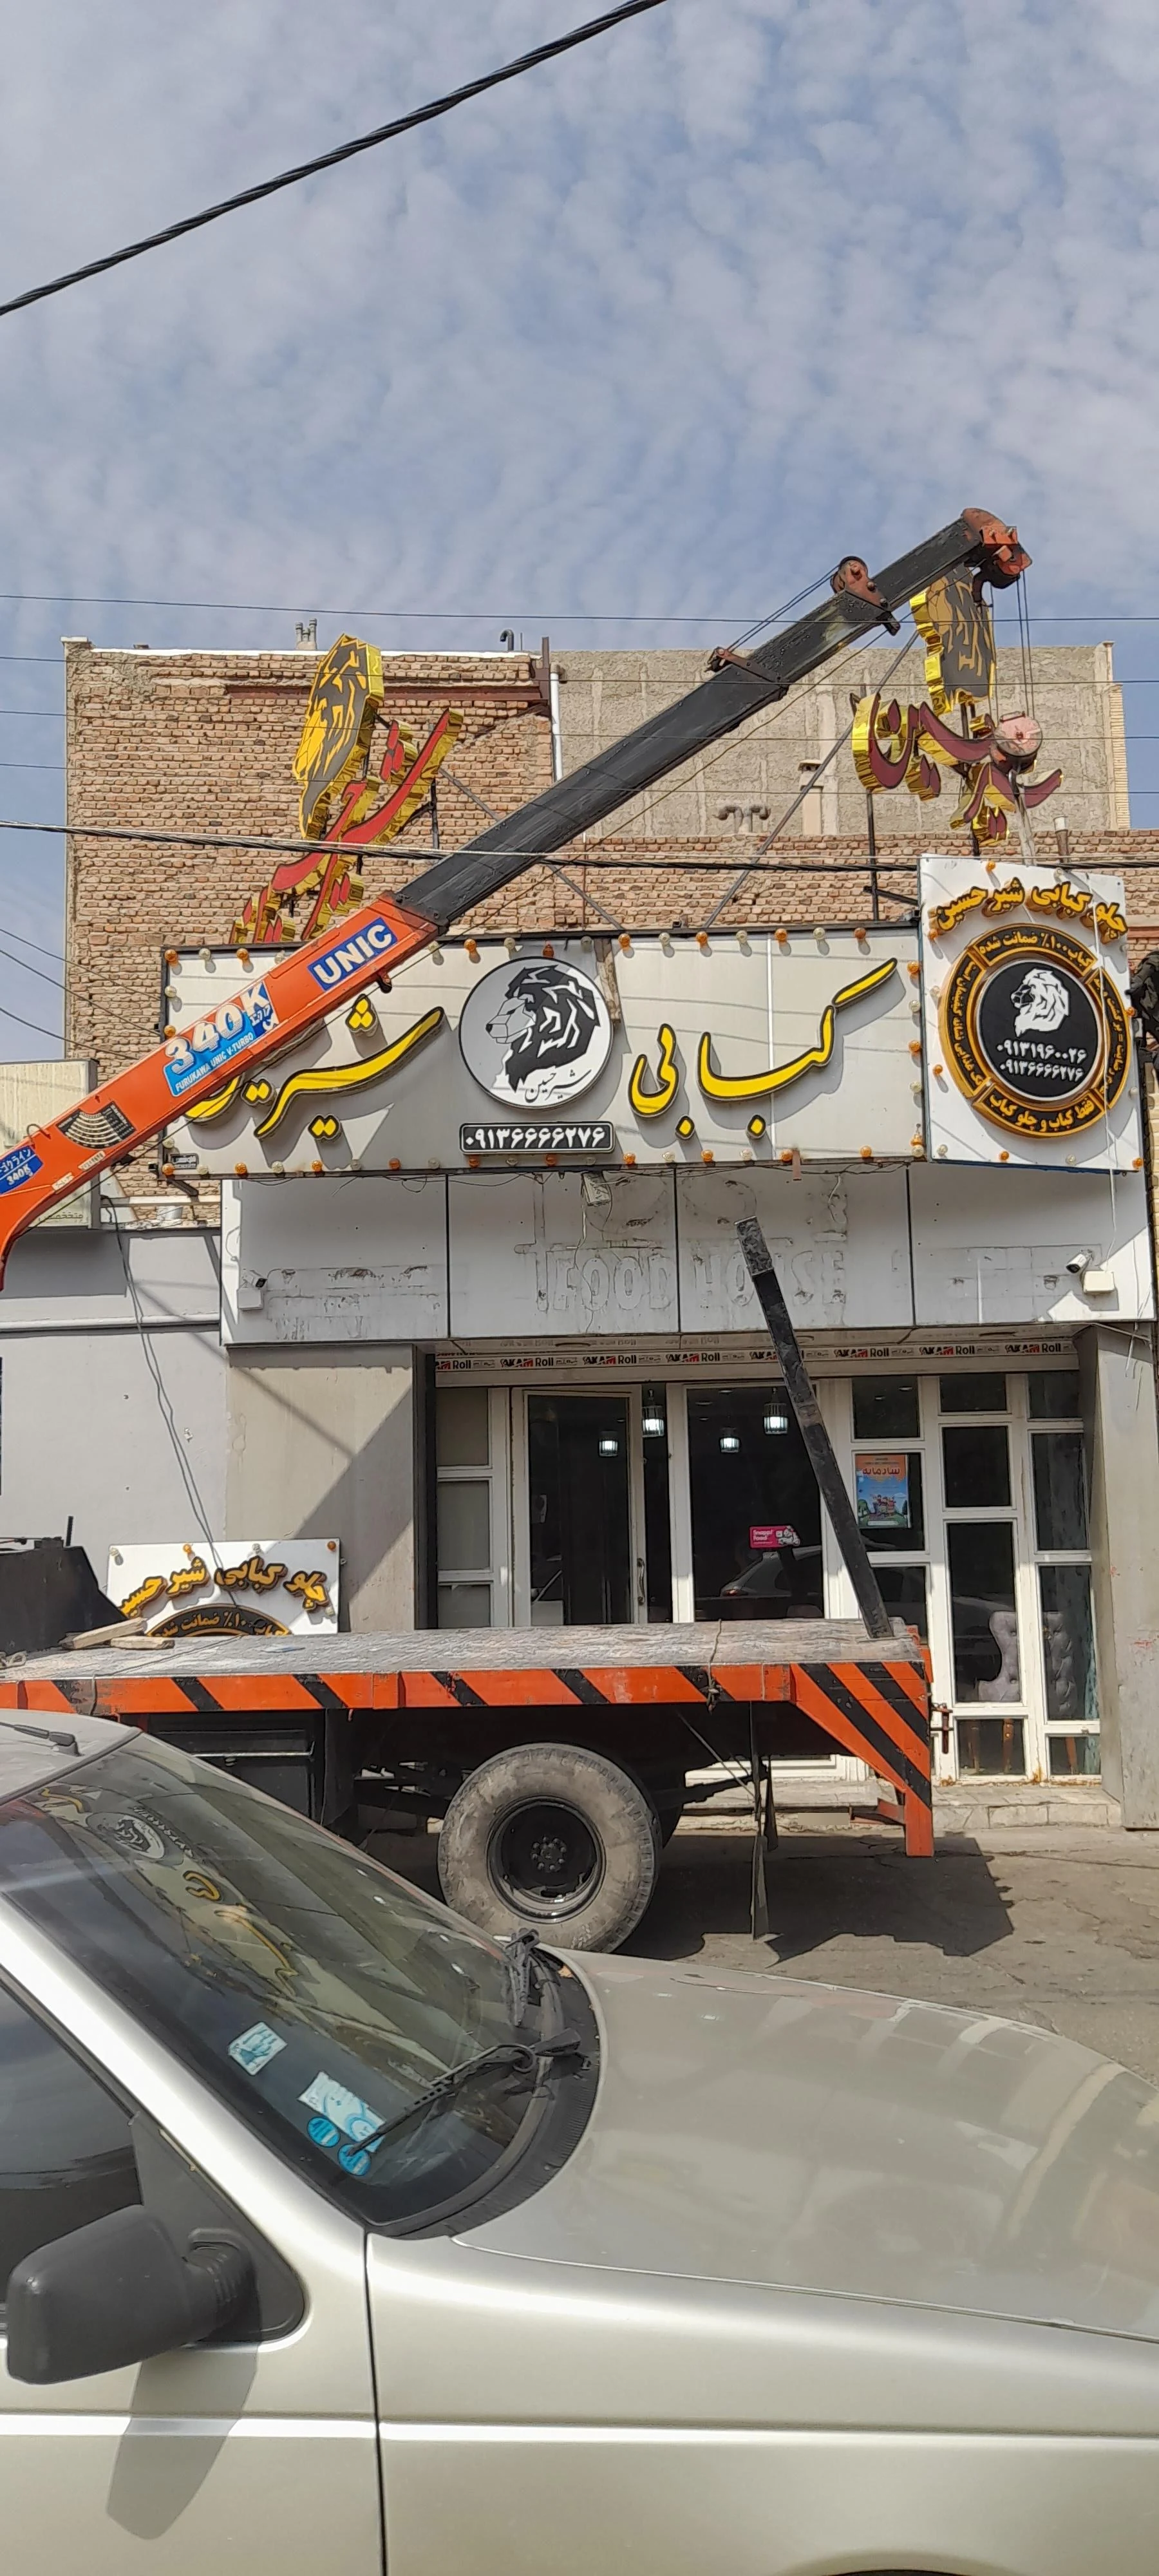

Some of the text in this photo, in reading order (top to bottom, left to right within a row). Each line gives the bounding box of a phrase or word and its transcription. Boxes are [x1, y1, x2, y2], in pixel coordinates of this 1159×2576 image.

[937, 876, 1128, 940] چلو کبابی شیر حسین
[979, 936, 1002, 955] شده
[1003, 931, 1038, 945] ضمانت
[312, 923, 393, 984] UNIC
[165, 981, 270, 1075] 340K
[628, 957, 898, 1139] کبابی
[997, 1039, 1088, 1064] ۰۹۱۳۱۹۶۰۰۲۶
[175, 1063, 211, 1092] FURUKAWA
[210, 1050, 227, 1067] UNIC
[999, 1059, 1084, 1082] ۰۹۱۳۶۶۶۶۲۷۶
[525, 1068, 592, 1103] شیر حسین
[989, 1095, 1018, 1117] کباب
[1074, 1097, 1095, 1119] فقط
[1039, 1119, 1048, 1132] و
[1048, 1109, 1074, 1132] کباب
[466, 1127, 605, 1149] ۰۹۱۳۶۶۶۶۲۷۶
[701, 1352, 720, 1362] Roll
[870, 1348, 889, 1358] Roll
[956, 1345, 975, 1355] Roll
[1042, 1343, 1061, 1353] Roll
[453, 1359, 471, 1370] Roll
[536, 1358, 554, 1367] Roll
[618, 1355, 637, 1364] Roll
[118, 1555, 327, 1617] چلو کبابی شیر حسی
[181, 1612, 220, 1631] ضمانت
